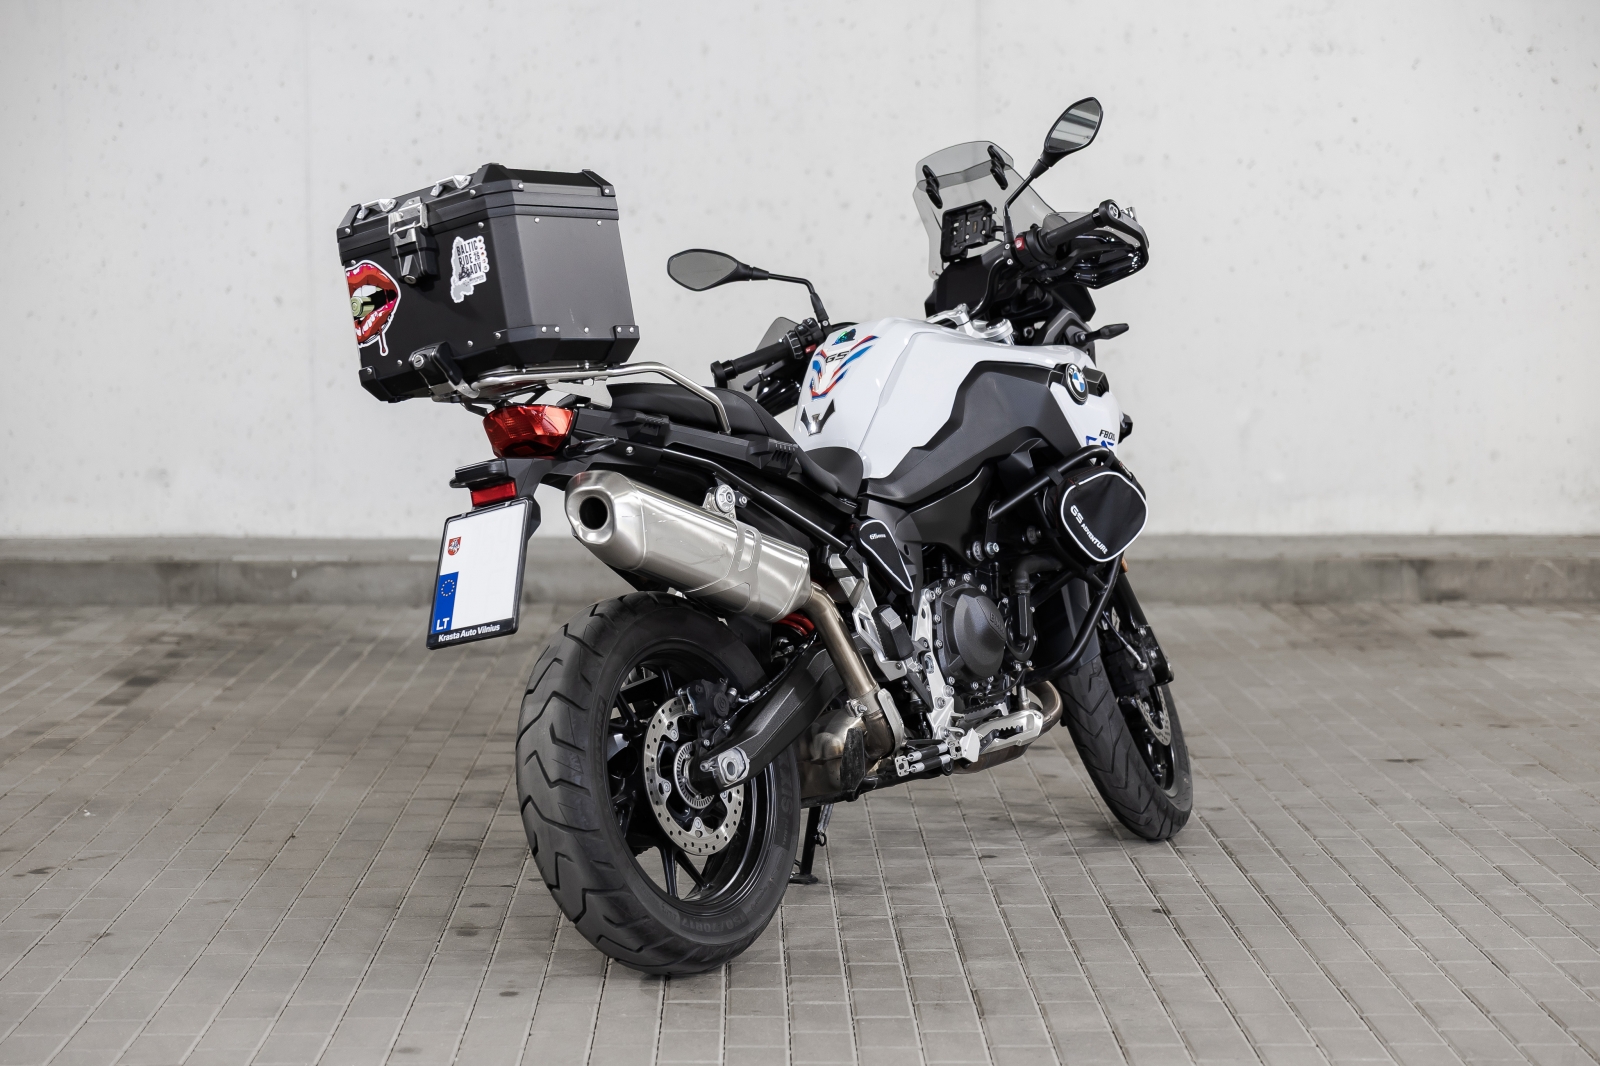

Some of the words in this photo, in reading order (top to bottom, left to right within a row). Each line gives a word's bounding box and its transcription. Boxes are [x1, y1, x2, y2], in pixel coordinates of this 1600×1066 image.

[456, 240, 478, 256] BALTIC
[458, 253, 473, 268] RIDE
[469, 261, 482, 275] ADV
[825, 350, 850, 364] GS
[1070, 504, 1084, 524] GS
[1081, 523, 1108, 555] ADVENTURE
[436, 617, 450, 631] LT
[438, 632, 460, 642] Krasta
[460, 629, 477, 638] Auto
[477, 624, 500, 634] Vilnius
